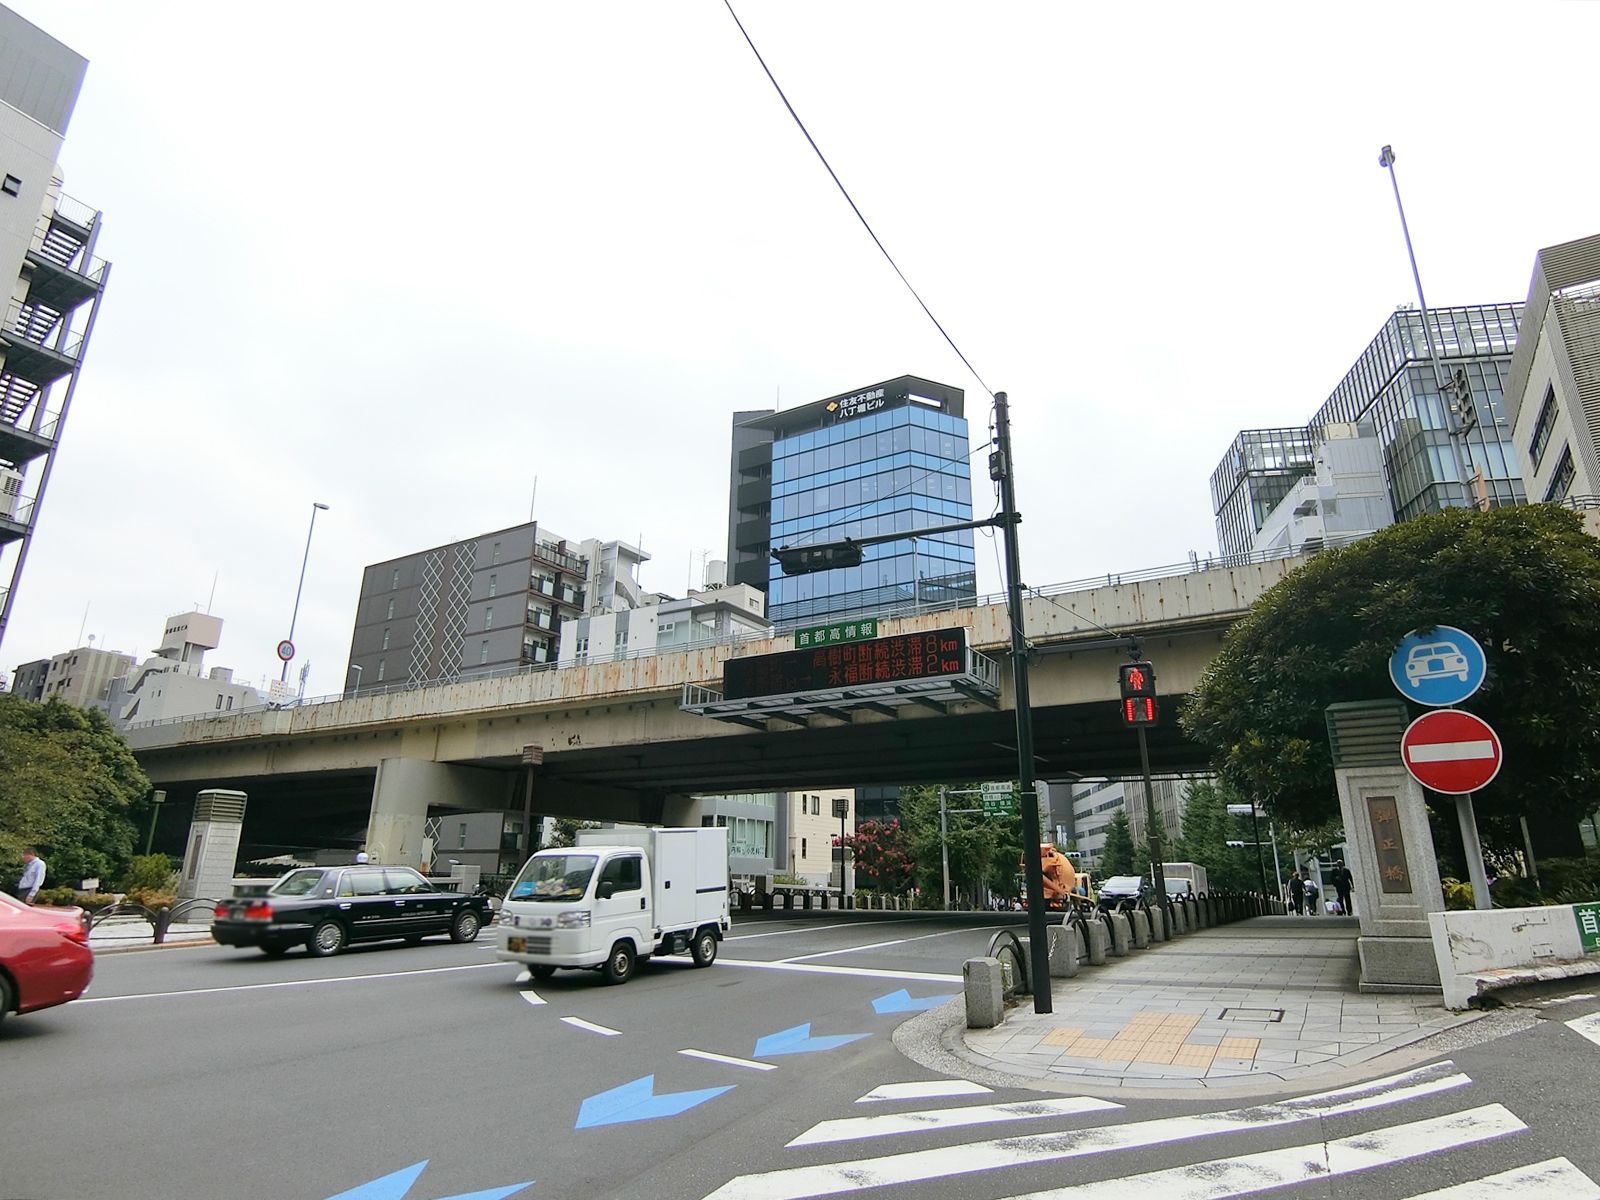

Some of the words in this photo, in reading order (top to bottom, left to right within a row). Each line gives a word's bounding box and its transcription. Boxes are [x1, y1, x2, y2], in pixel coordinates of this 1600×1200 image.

[840, 389, 885, 409] 住友不動産
[840, 399, 885, 418] 八丁堀ビル
[799, 622, 873, 645] 首都高情報
[281, 646, 292, 656] 40
